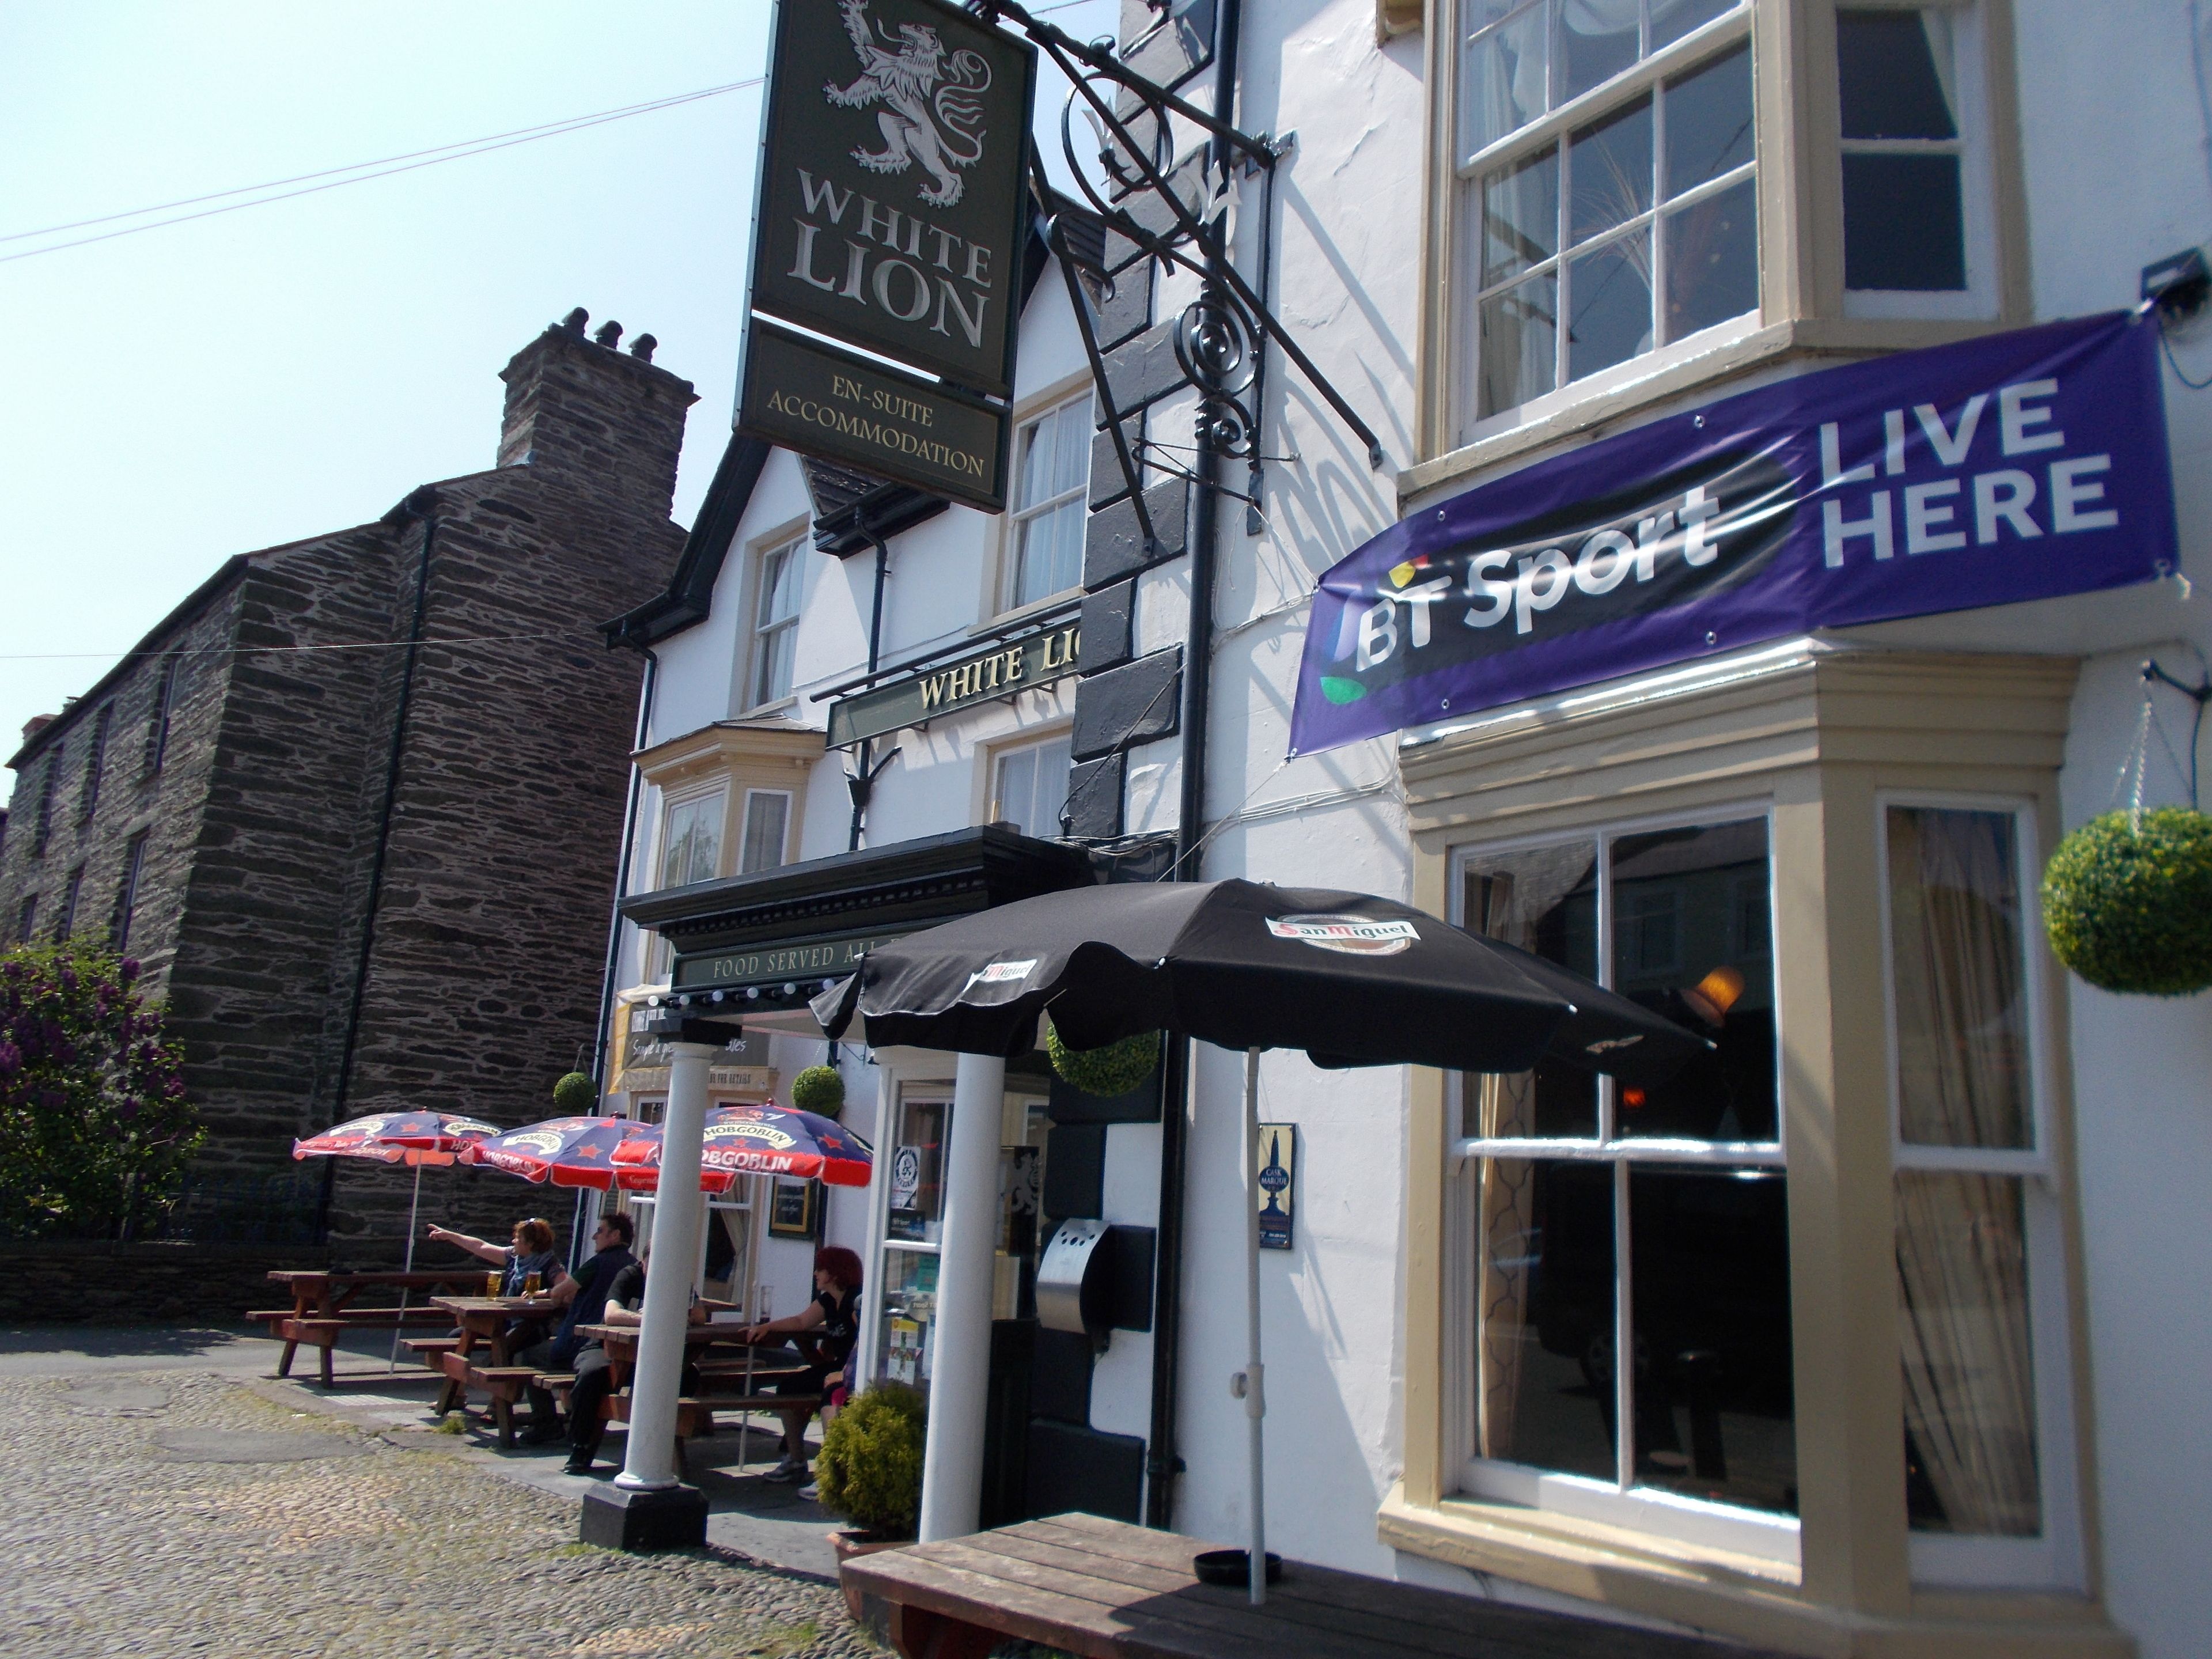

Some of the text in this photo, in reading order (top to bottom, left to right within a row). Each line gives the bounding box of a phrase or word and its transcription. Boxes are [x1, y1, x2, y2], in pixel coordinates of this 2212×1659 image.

[797, 168, 991, 287] WHITE
[787, 217, 991, 349] LION
[767, 390, 984, 478] ACCOMMODATION
[832, 375, 933, 427] EN-SUITE
[1820, 378, 2065, 484] LIVE
[1823, 454, 2119, 569] HERE
[1356, 486, 1720, 672] BT Sport
[919, 646, 1024, 710] WHITE
[714, 956, 759, 978] FOOD
[767, 946, 834, 972] SERVED
[702, 1150, 793, 1170] OBGOBLIN
[704, 1126, 787, 1142] HOBGOBLIN
[1261, 1177, 1287, 1185] MARQUE
